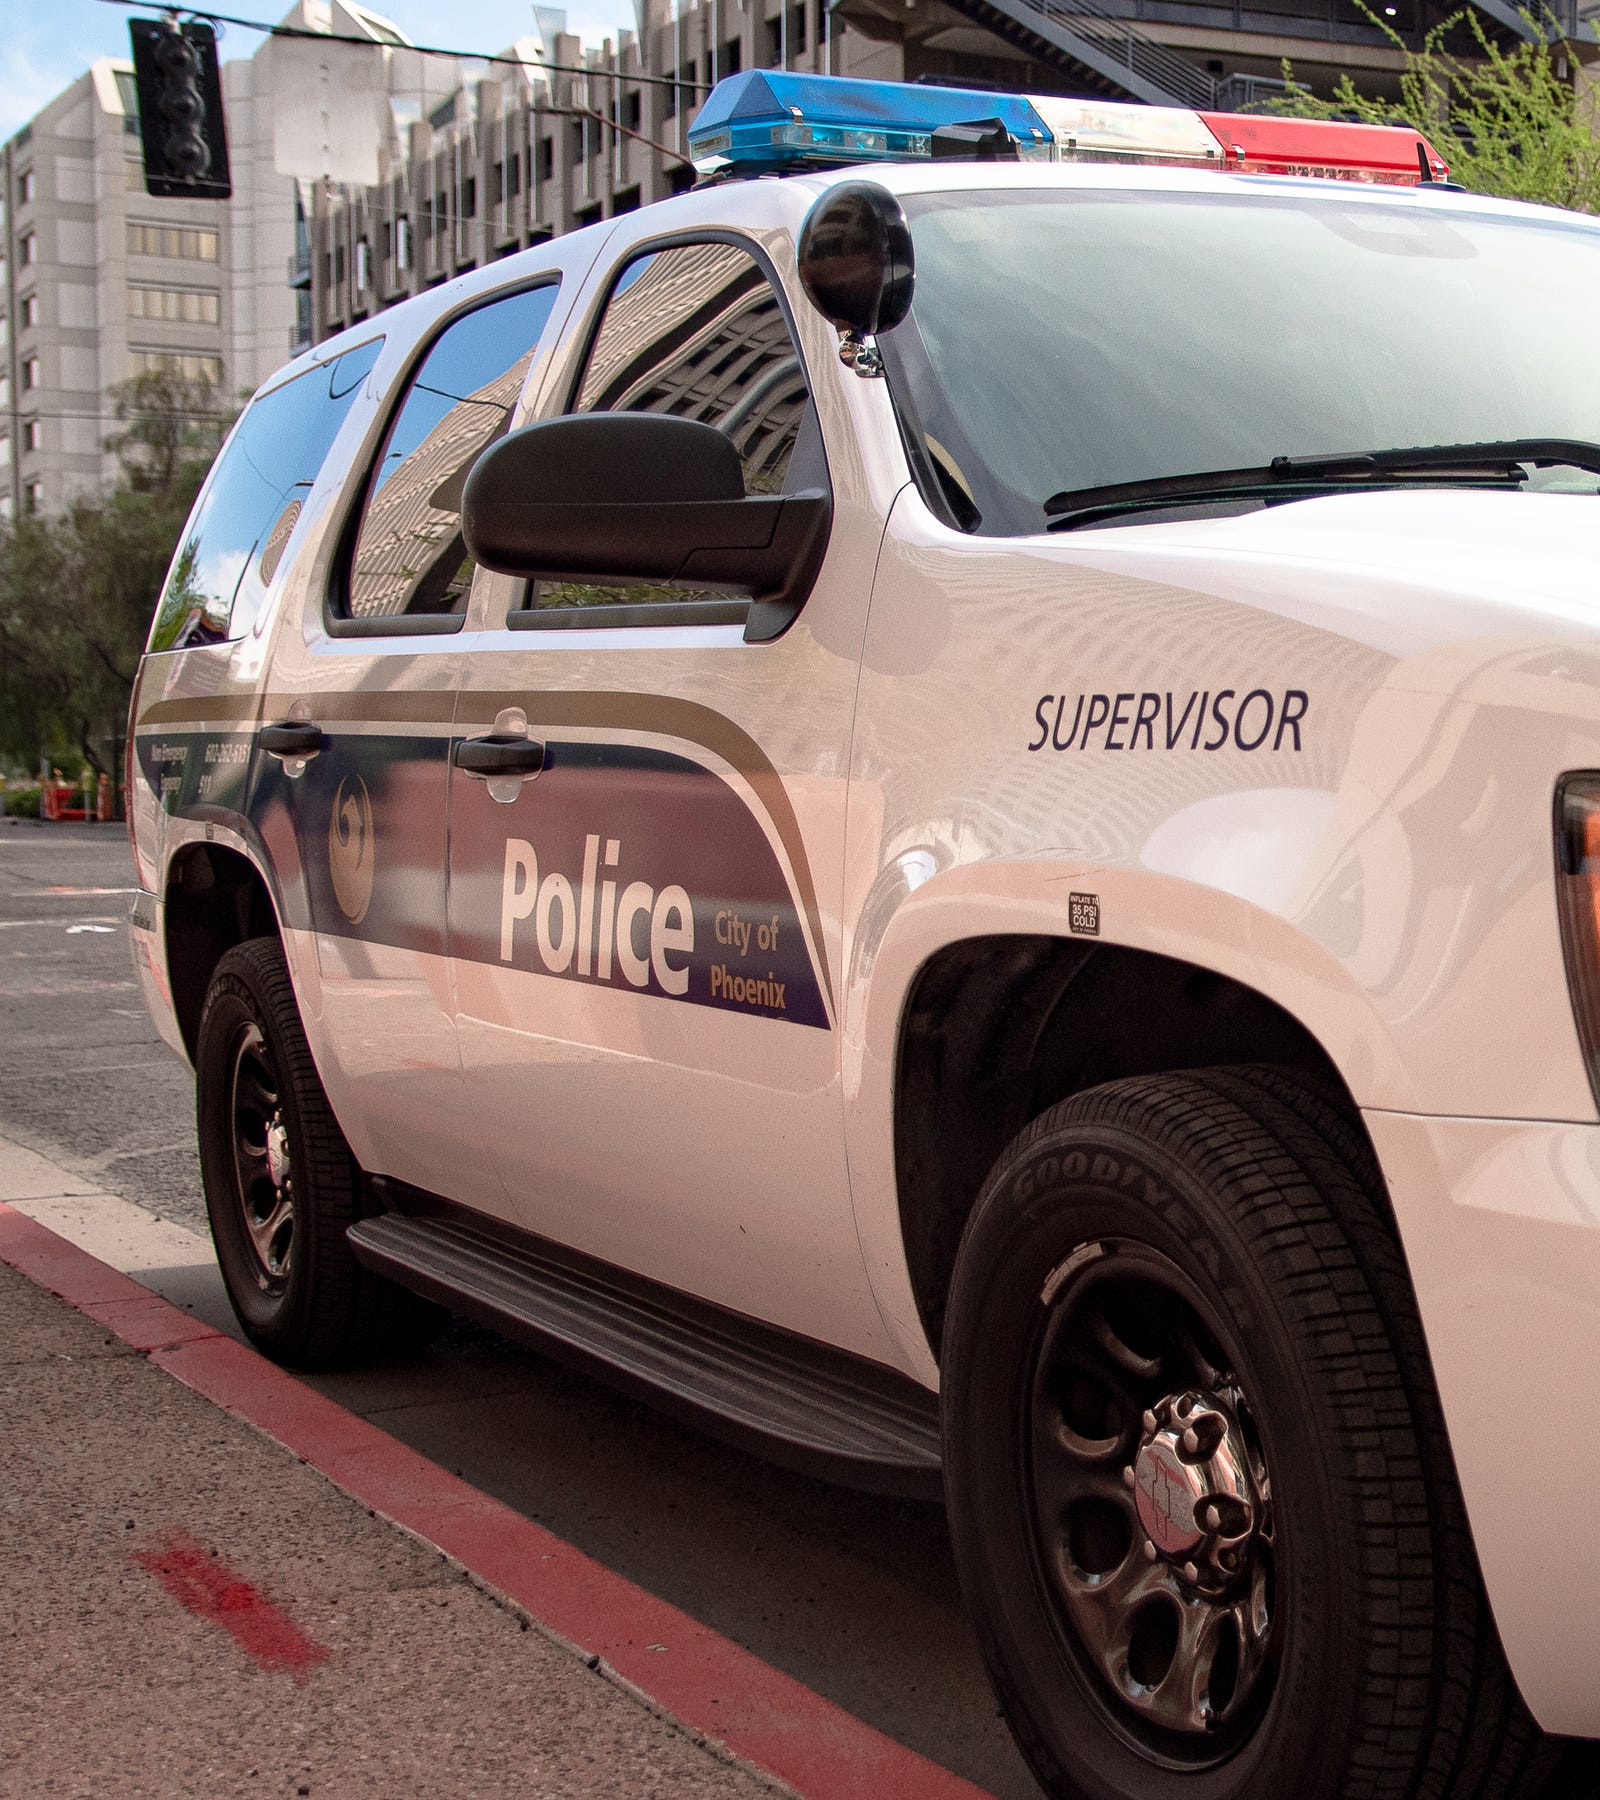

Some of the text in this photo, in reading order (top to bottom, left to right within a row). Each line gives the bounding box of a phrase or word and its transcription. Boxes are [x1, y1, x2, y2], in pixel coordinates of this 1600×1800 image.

[1028, 689, 1309, 751] SUPERVISOR
[198, 775, 212, 794] 911
[500, 834, 695, 995] Police
[1072, 904, 1097, 917] 35 PSI
[1073, 915, 1096, 928] COLD
[715, 910, 779, 956] City of
[710, 965, 786, 1009] Phoenix
